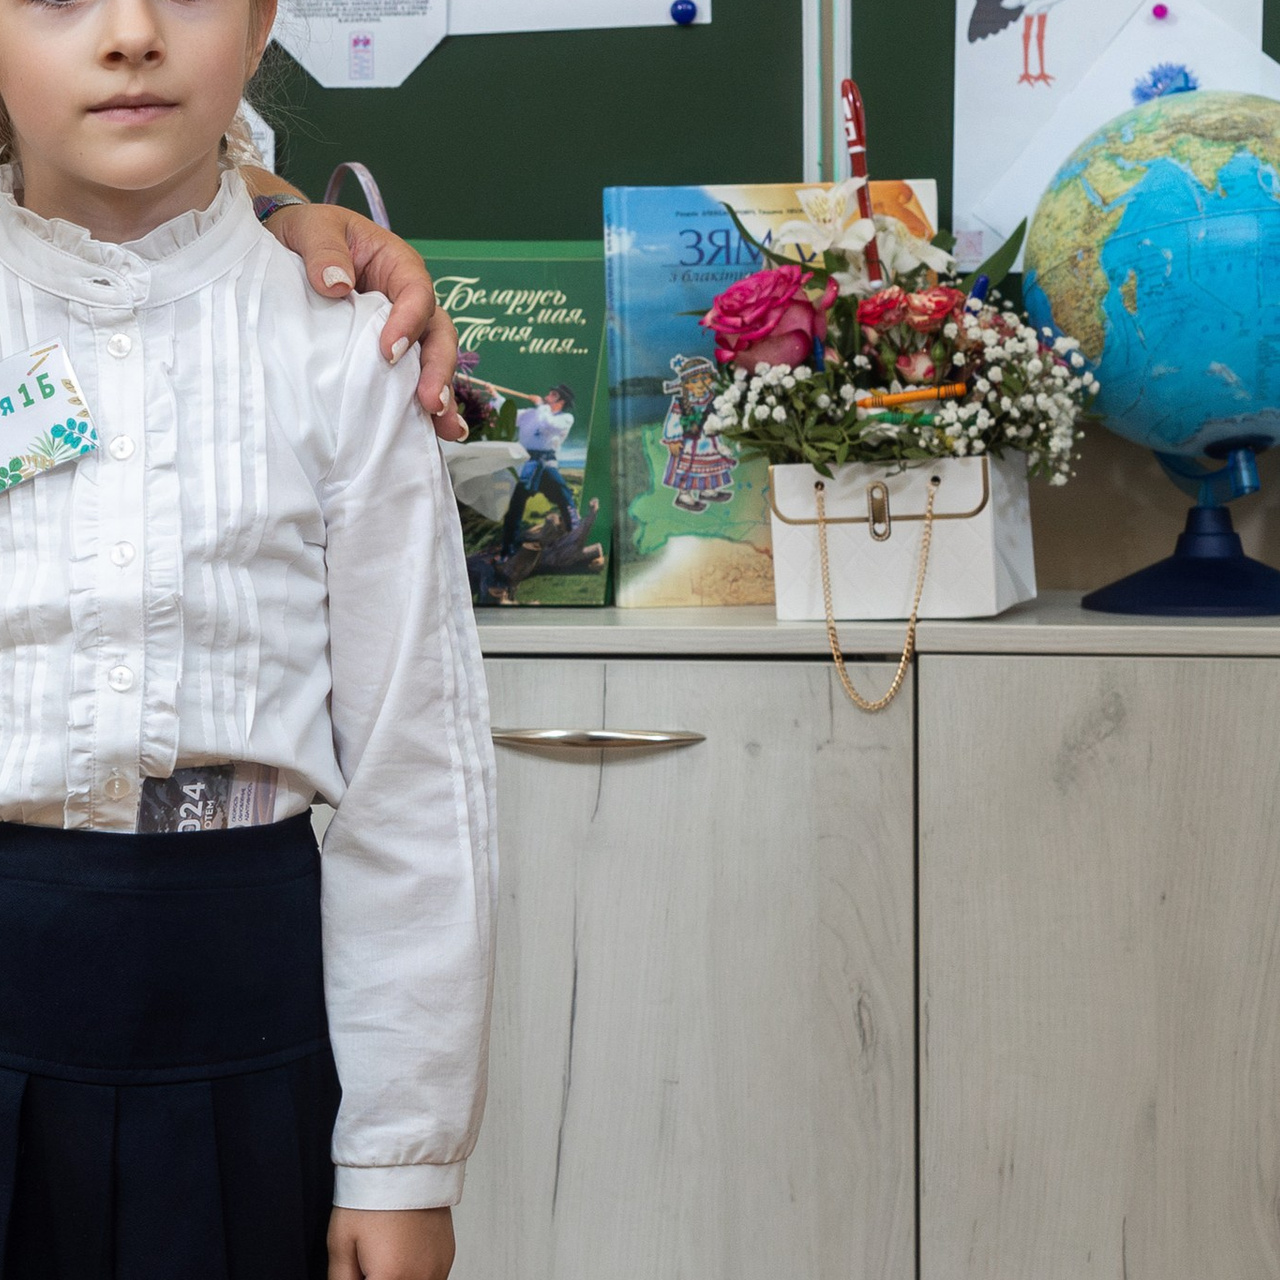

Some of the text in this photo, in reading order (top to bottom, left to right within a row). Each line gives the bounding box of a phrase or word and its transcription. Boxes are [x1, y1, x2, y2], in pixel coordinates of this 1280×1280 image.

[432, 275, 568, 316] Беларусь
[452, 316, 533, 352] Песня
[527, 306, 587, 326] мая,
[519, 336, 589, 355] мая...
[17, 383, 35, 408] 1
[35, 372, 56, 400] Б
[177, 782, 206, 833] 024
